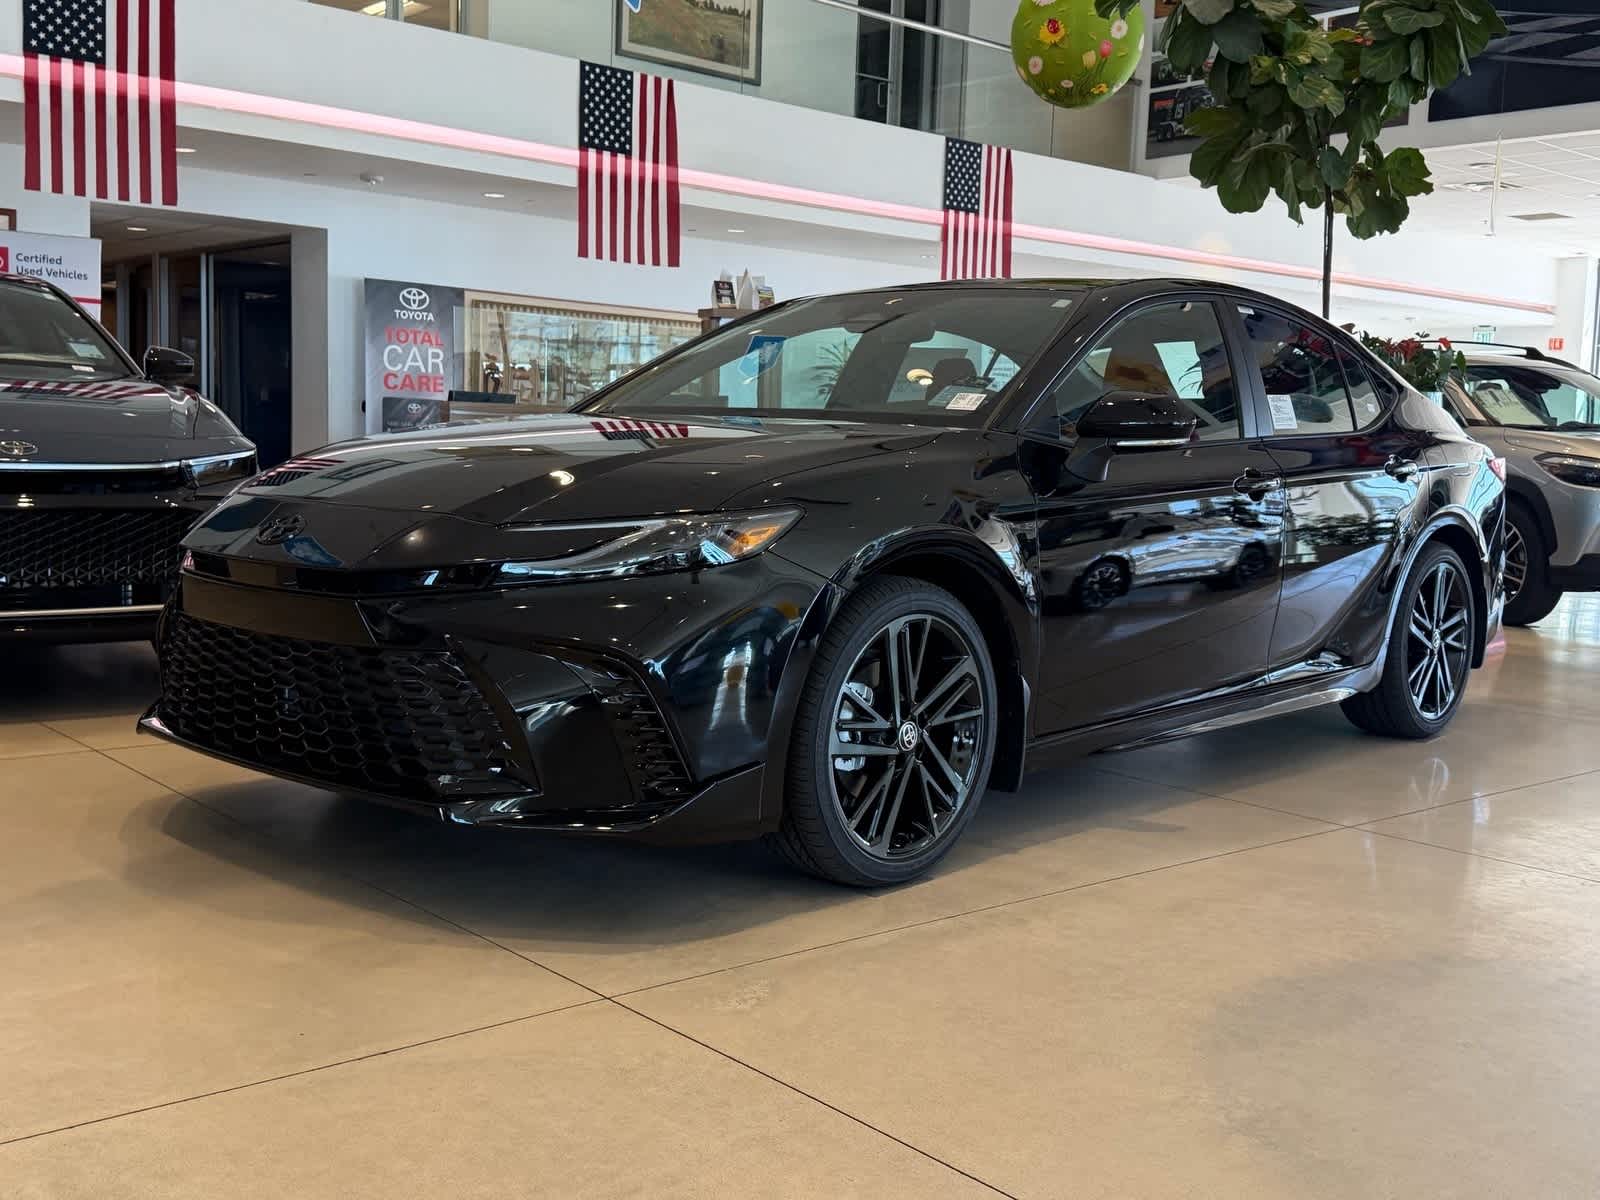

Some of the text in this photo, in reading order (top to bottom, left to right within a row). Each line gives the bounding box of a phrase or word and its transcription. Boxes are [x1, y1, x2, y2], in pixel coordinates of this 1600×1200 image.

[16, 252, 63, 265] Certified
[16, 265, 89, 281] Used Vehicles
[394, 309, 435, 321] TOYOTA
[384, 326, 444, 347] TOTAL
[383, 344, 444, 374] CAR
[383, 372, 444, 393] CARE
